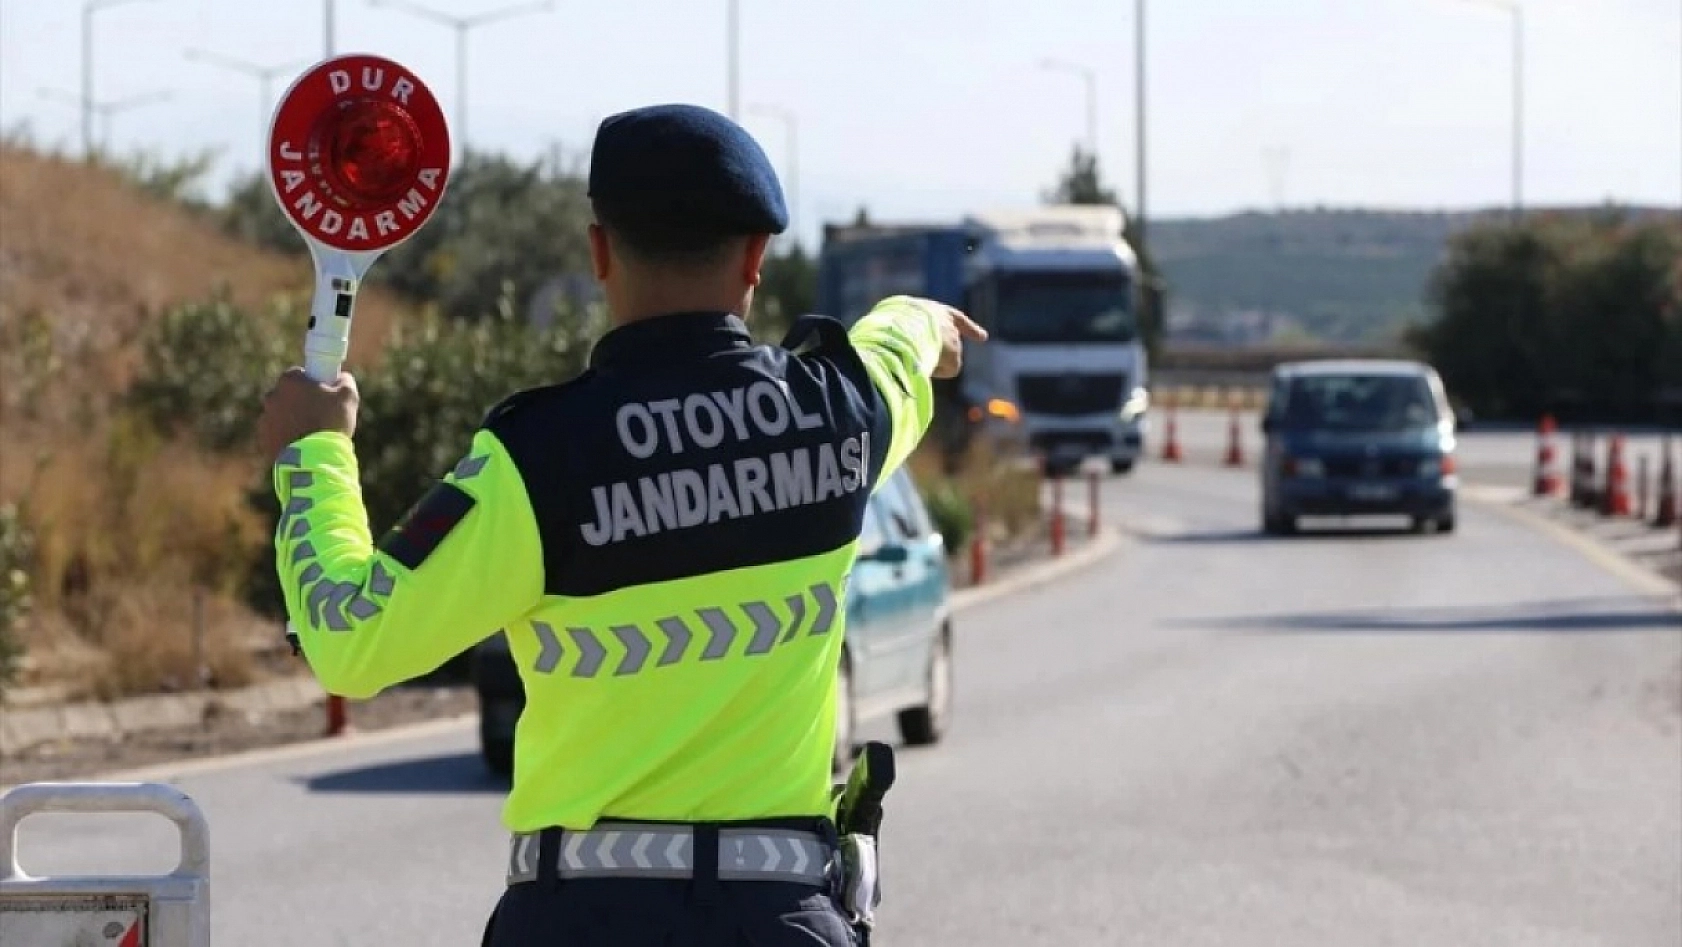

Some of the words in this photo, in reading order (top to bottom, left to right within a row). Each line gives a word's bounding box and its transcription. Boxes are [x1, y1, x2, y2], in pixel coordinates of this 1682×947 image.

[329, 66, 414, 105] DUR
[279, 141, 443, 240] JANDARMA
[615, 380, 824, 459] OTOYOL
[580, 431, 871, 546] JANDARMASI
